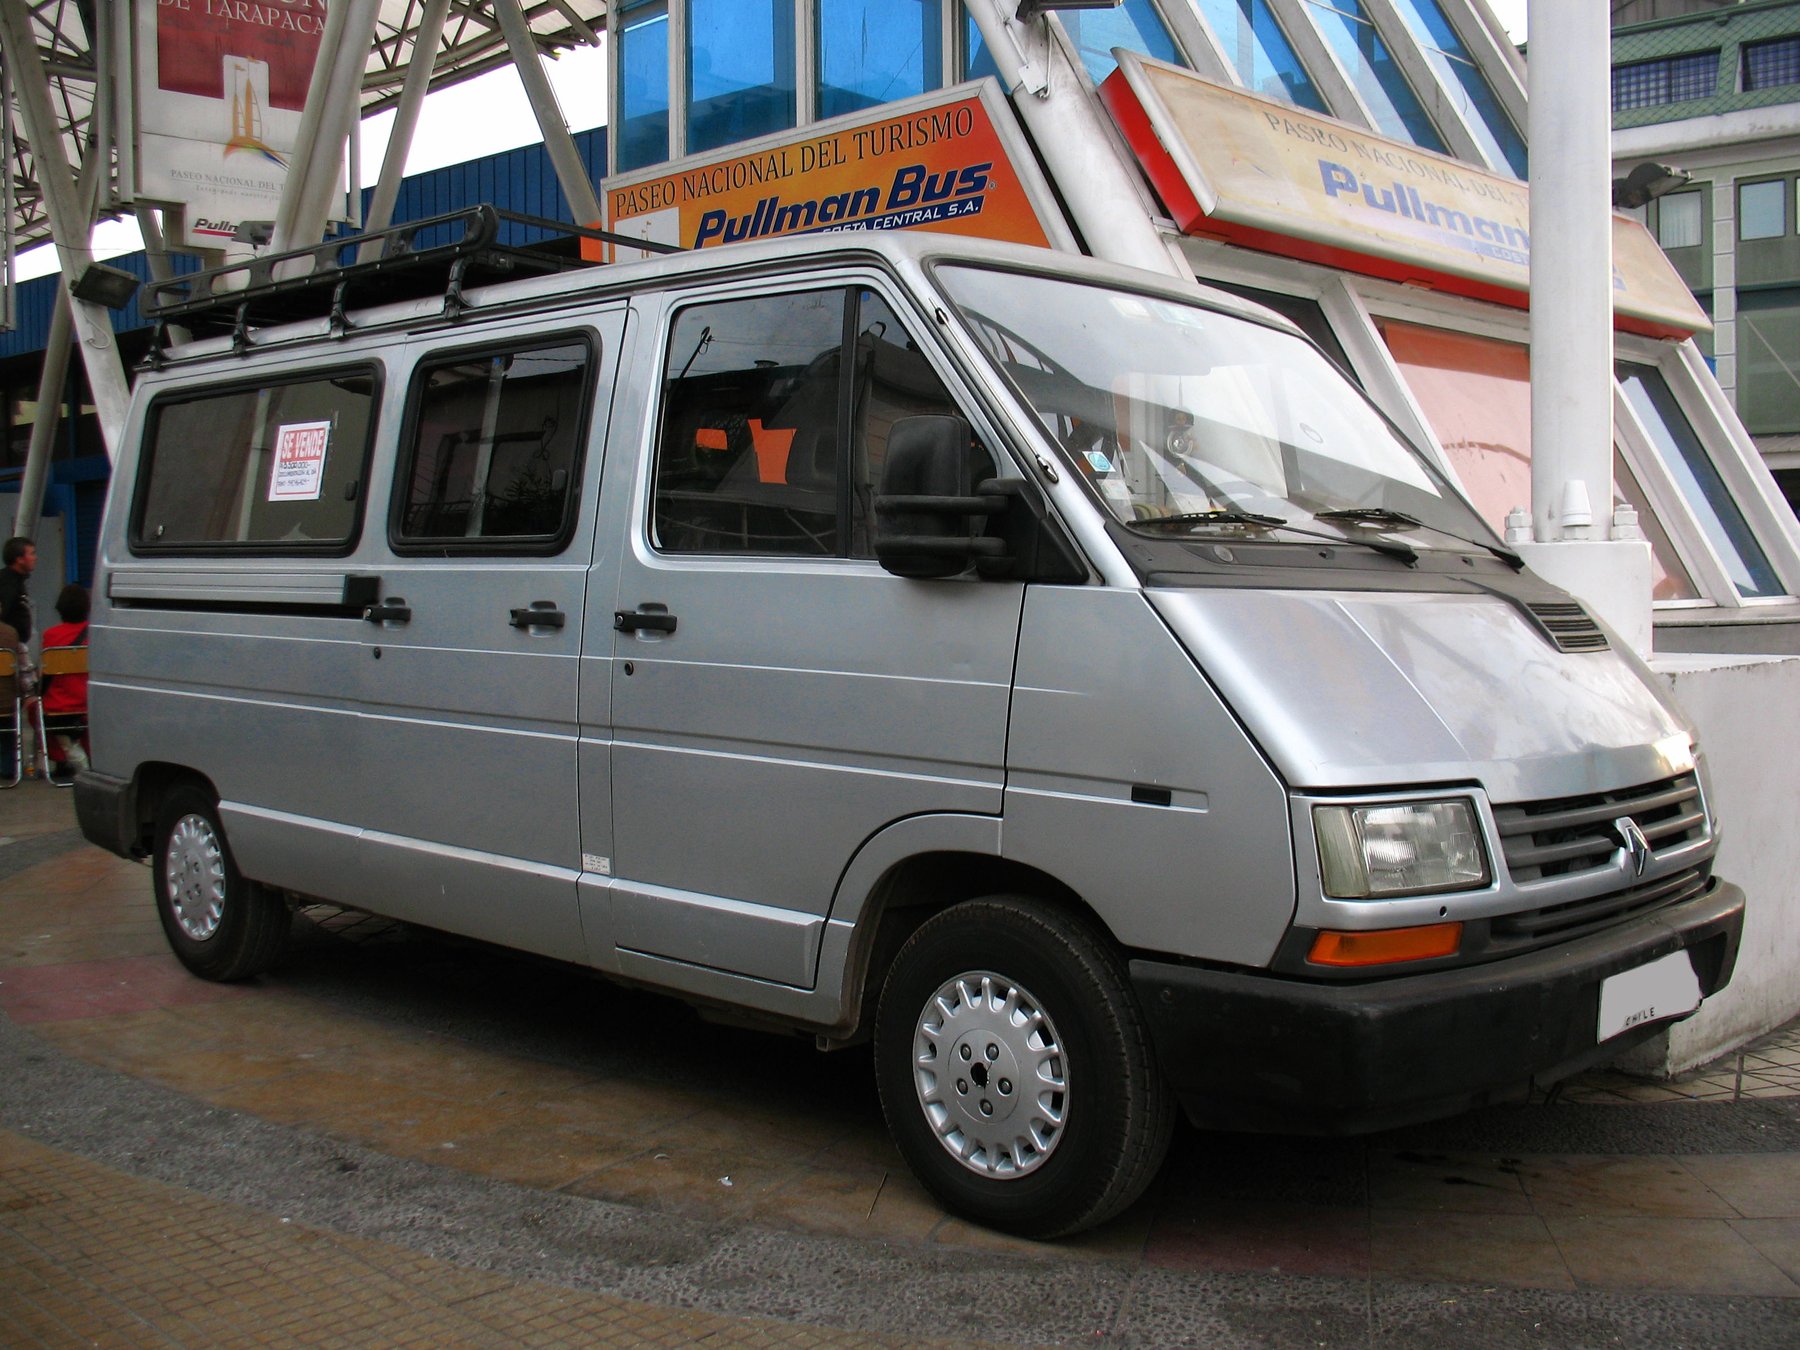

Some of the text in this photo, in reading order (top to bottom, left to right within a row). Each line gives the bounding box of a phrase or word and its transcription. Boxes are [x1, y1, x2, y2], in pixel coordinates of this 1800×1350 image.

[171, 169, 202, 180] PASEO
[205, 174, 255, 188] NACIONAL
[258, 181, 277, 190] DEL
[614, 106, 974, 218] PASEO NACIONAL DEL TURISMO
[1263, 111, 1513, 206] PASEO NACIONAL DEL
[693, 162, 993, 249] Pullman Bus
[872, 207, 941, 231] CENTRAL
[947, 200, 979, 216] S.A.
[1317, 158, 1529, 250] Pullman
[281, 430, 325, 460] SE VENDE
[1625, 1006, 1655, 1026] CHILE
